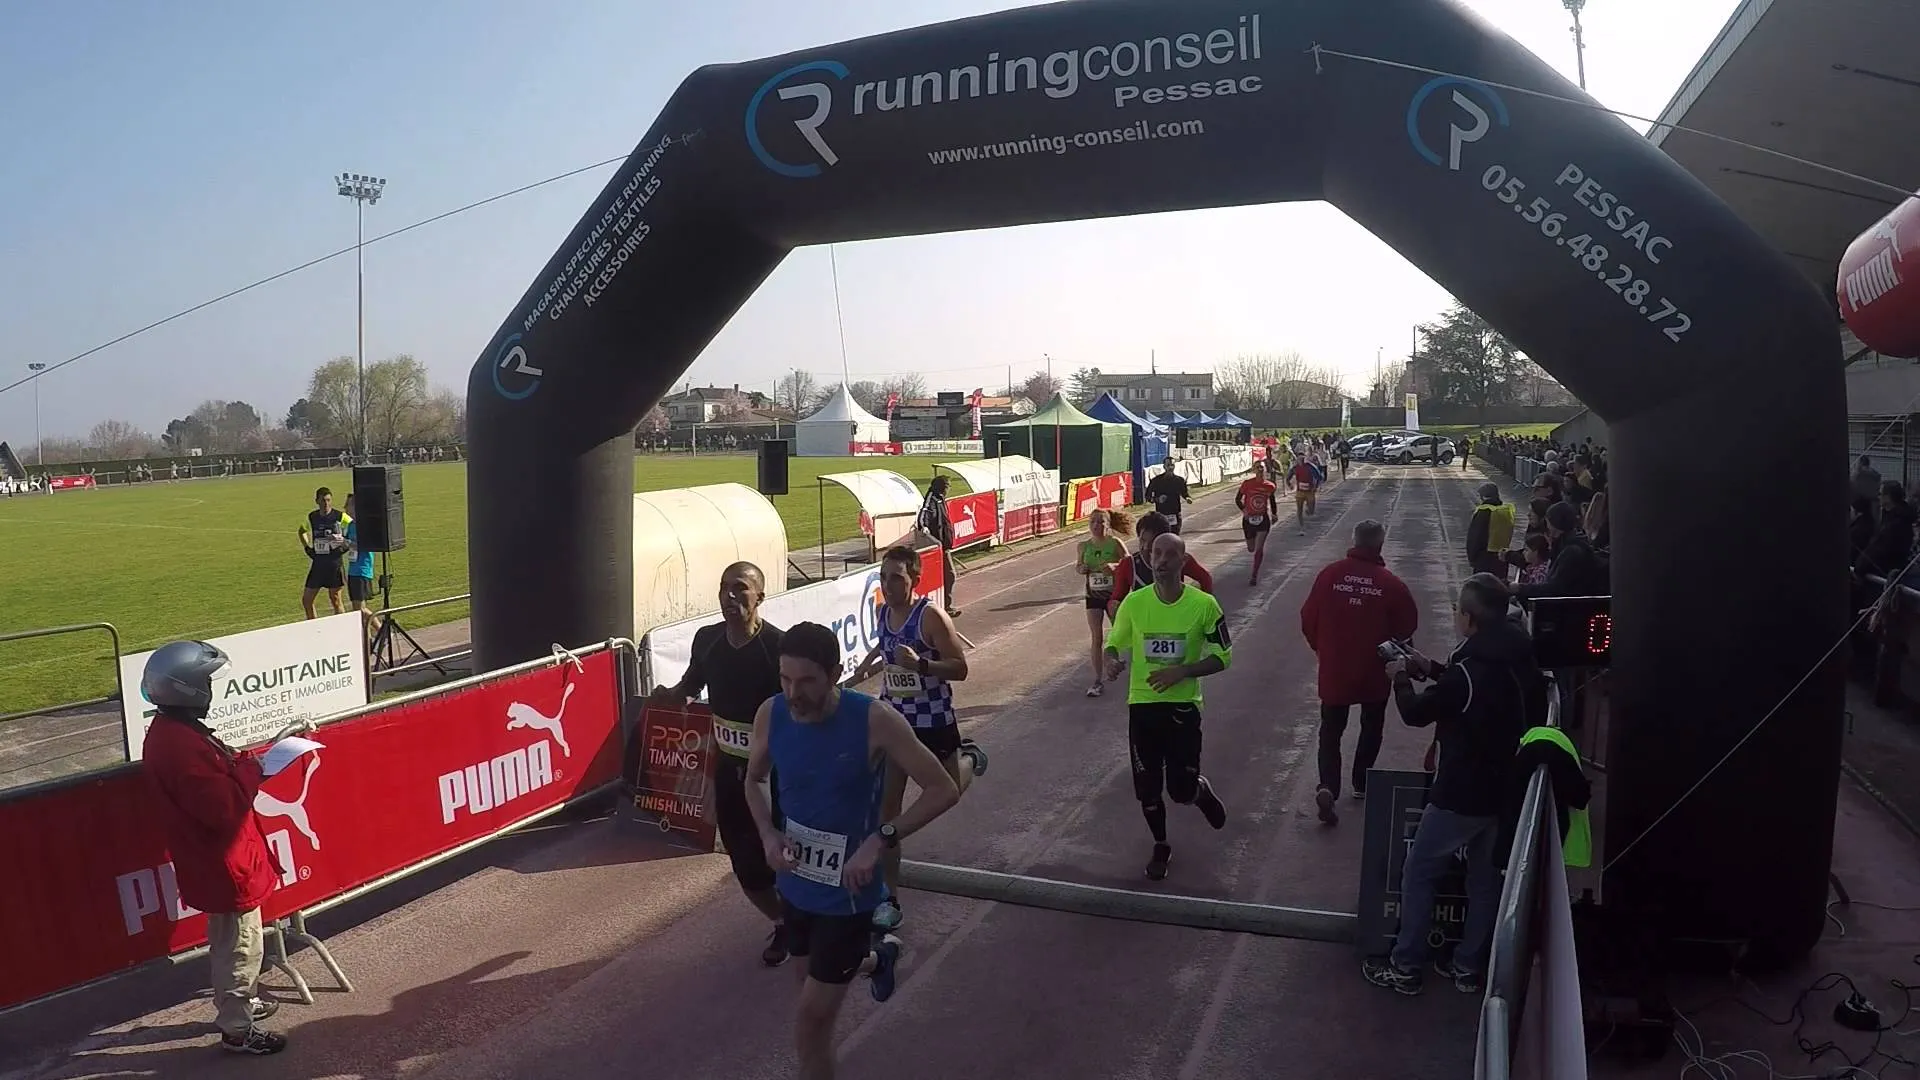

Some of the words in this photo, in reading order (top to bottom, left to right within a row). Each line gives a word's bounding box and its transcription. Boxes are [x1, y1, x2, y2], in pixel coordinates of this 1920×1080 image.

[853, 14, 1262, 115] runningconseil
[1115, 75, 1263, 107] Pessac
[928, 119, 1204, 165] www.running-conseil.com
[1555, 163, 1673, 264] PESSAC
[523, 271, 567, 331] MAGASIN
[565, 196, 624, 275] SPECIALISTE
[622, 134, 673, 199] RUNNING
[549, 238, 612, 321] CHAUSSURES
[612, 175, 662, 237] TEXTILES
[1482, 164, 1692, 343] 05.56.48.28.72
[583, 220, 651, 307] ACCESSOIRES
[1846, 246, 1899, 312] PUMA
[1333, 584, 1354, 593] HORS
[1360, 587, 1383, 596] STADE
[1349, 597, 1362, 605] FFA
[1152, 640, 1176, 653] 281
[224, 653, 351, 699] AQUITAINE
[280, 690, 292, 703] ET
[295, 676, 353, 699] IMMOBILIER
[888, 673, 916, 687] 1085
[216, 716, 248, 732] CRÉDIT
[250, 705, 294, 724] AGRICOLE
[218, 728, 248, 742] VENUE
[651, 725, 702, 753] PRO
[715, 725, 749, 747] 1015
[648, 748, 699, 770] TIMING
[438, 739, 553, 825] PUMA
[634, 794, 704, 817] FINISHLINE
